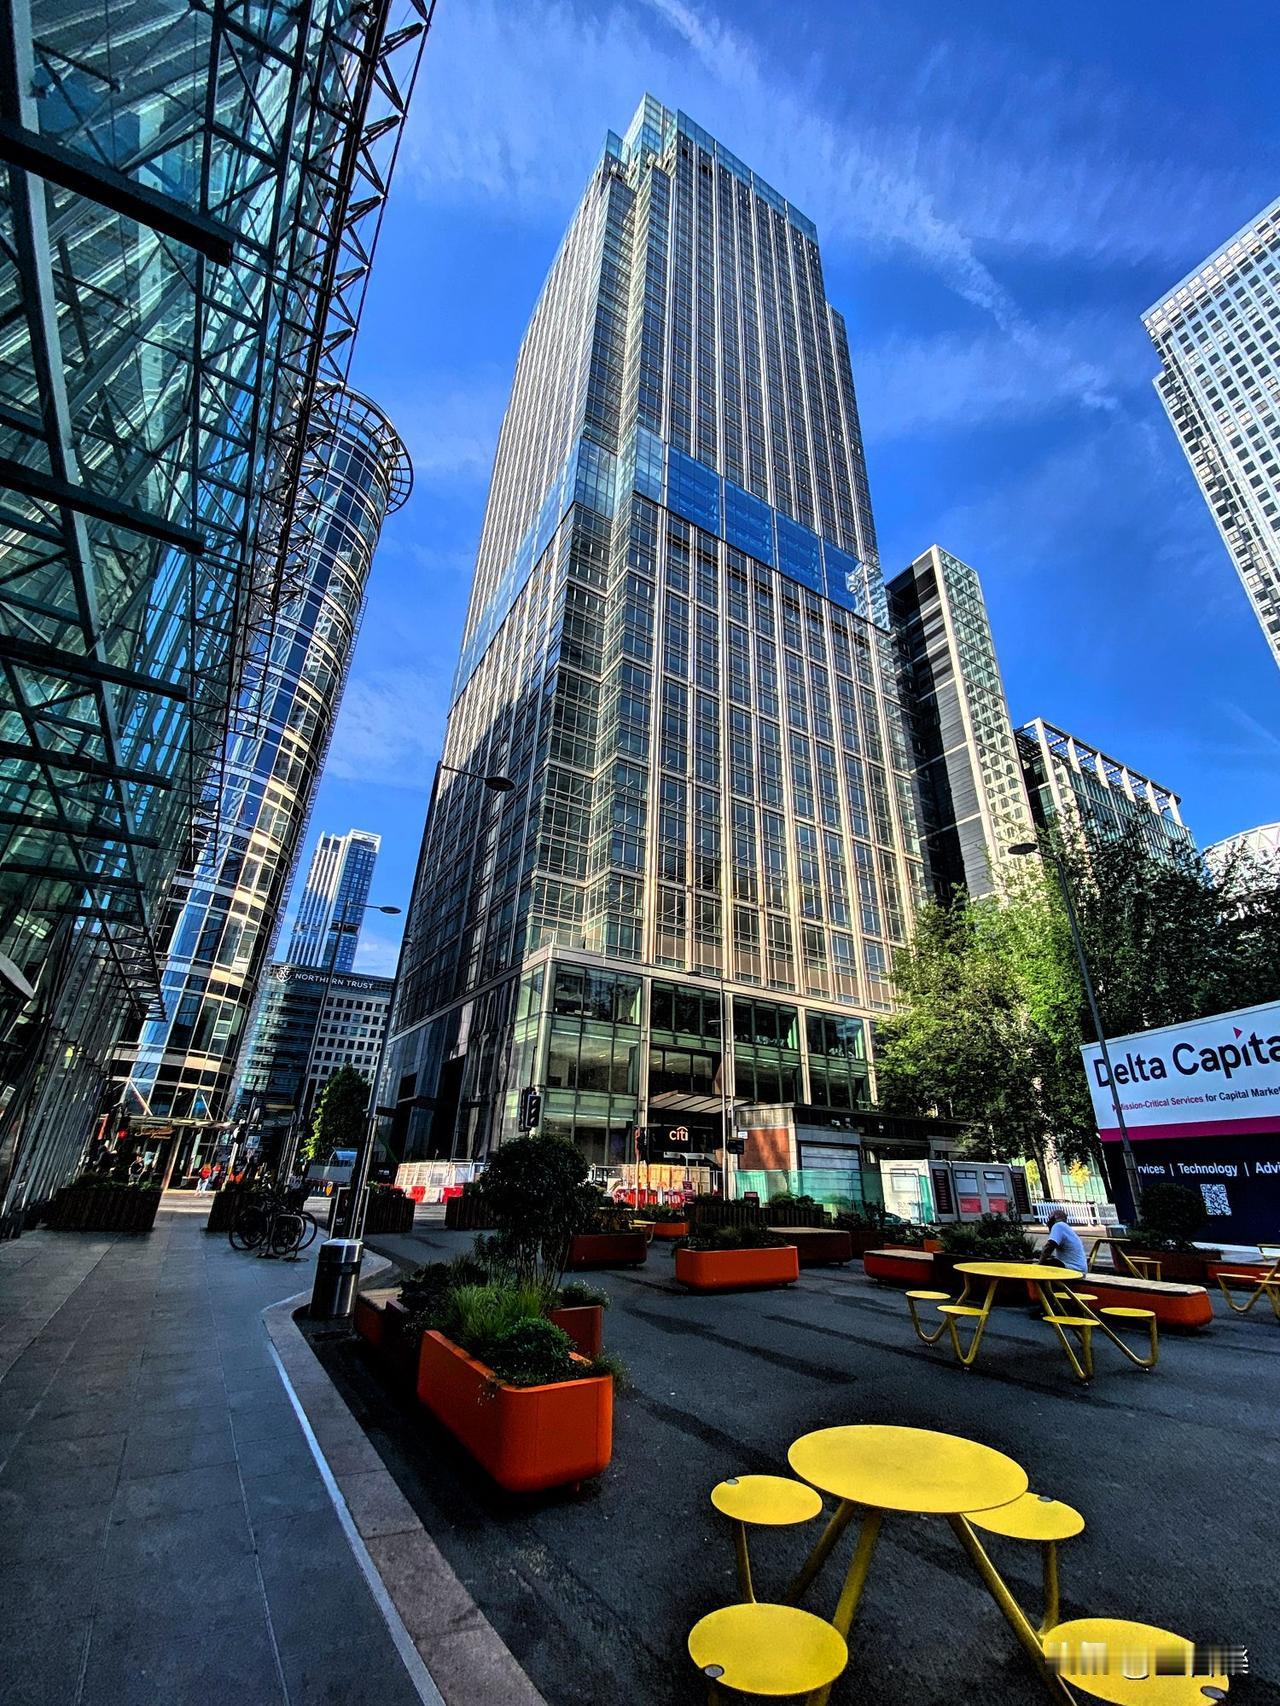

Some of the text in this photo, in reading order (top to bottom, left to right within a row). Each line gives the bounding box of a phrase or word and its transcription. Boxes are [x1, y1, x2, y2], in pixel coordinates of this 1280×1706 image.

[346, 980, 374, 989] TRUST
[1093, 1053, 1167, 1087] Delta
[1171, 1096, 1204, 1106] Services
[1205, 1094, 1217, 1102] for
[1219, 1089, 1249, 1101] Capital
[1250, 1086, 1280, 1097] Marke
[669, 1126, 689, 1141] citi
[1137, 1163, 1165, 1174] rvices
[1177, 1162, 1238, 1177] Technology
